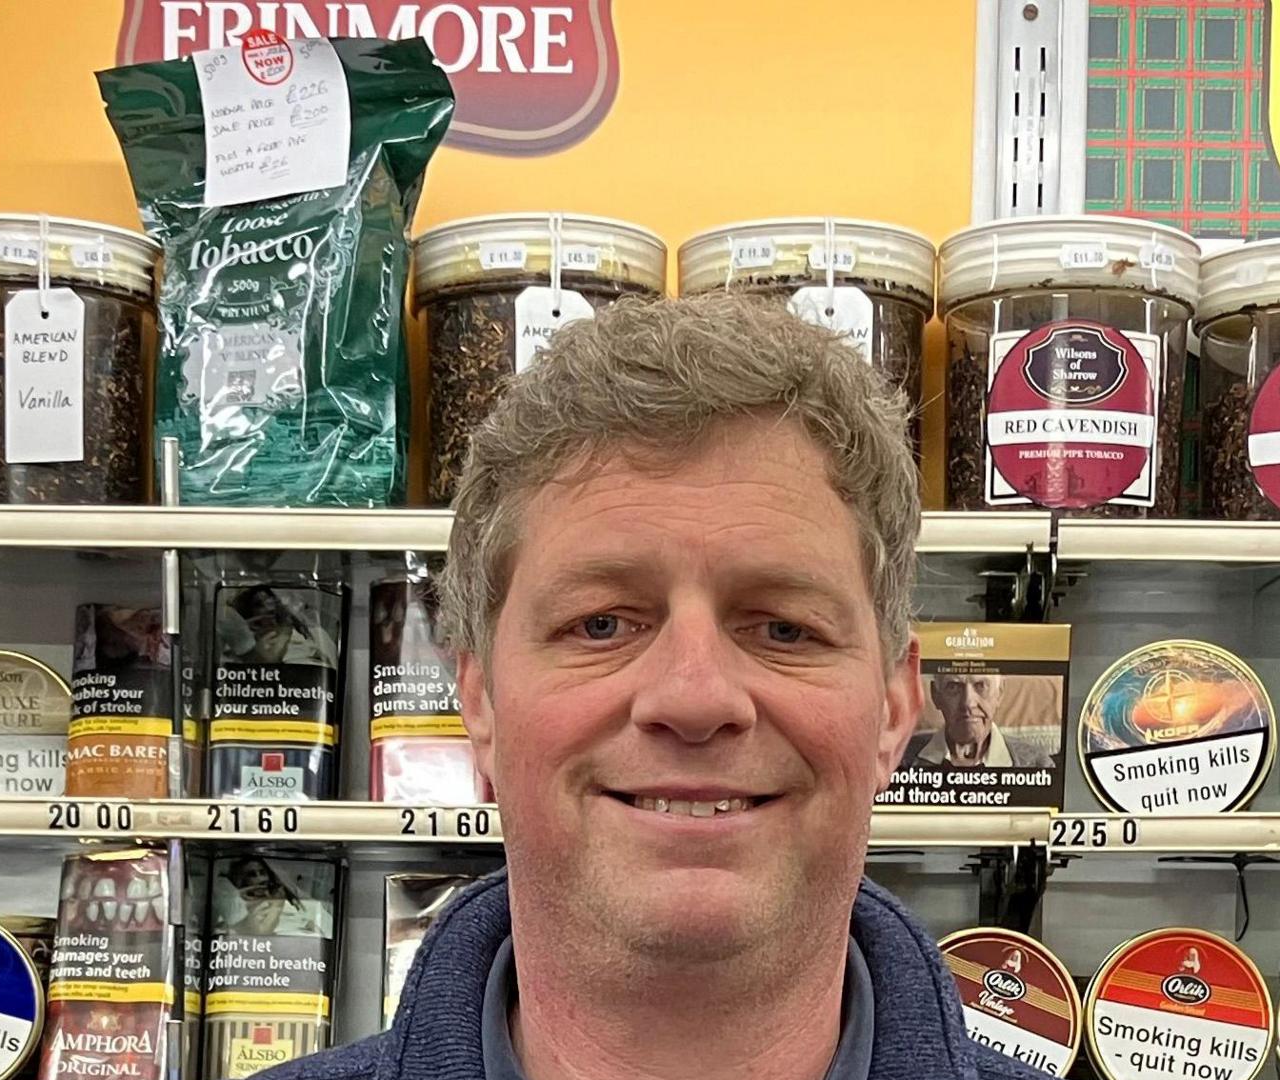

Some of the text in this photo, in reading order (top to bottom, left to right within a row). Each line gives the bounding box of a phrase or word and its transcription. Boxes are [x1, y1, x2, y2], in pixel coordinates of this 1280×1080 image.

[221, 212, 289, 234] Loose
[188, 234, 313, 271] Tobacco
[13, 329, 78, 344] AMERICAN
[22, 349, 69, 363] BLEND
[1055, 347, 1097, 361] Wilsons
[1053, 368, 1098, 381] Sharrow
[18, 389, 74, 410] Vanilla
[1004, 417, 1139, 437] RED CAVENDISH
[216, 665, 280, 683] Don't let
[215, 683, 334, 702] children breathe
[214, 702, 300, 718] your smoke
[1113, 746, 1251, 783] Smoking kills
[947, 769, 1051, 786] causes mouth
[909, 788, 1010, 804] throat cancer
[1141, 782, 1228, 811] quit now
[1098, 1016, 1258, 1063] Smoking kills
[1130, 1052, 1175, 1077] quit
